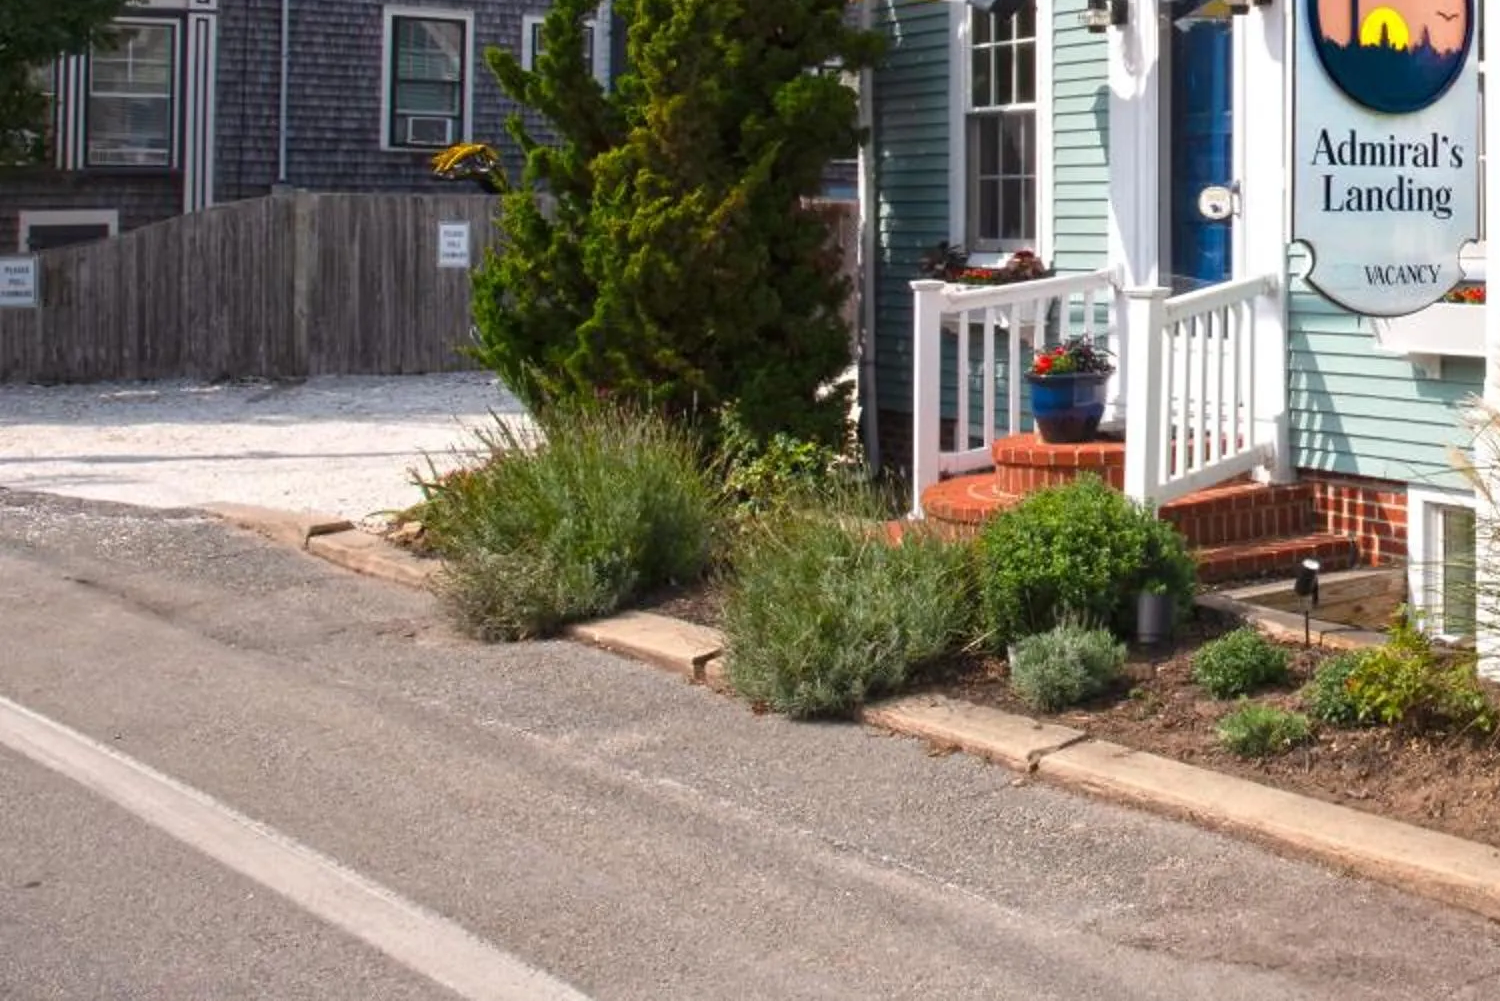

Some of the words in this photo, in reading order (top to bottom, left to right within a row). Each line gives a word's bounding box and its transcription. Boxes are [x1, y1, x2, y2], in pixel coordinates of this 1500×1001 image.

[1311, 128, 1464, 169] Admiral's
[1321, 173, 1453, 220] Landing
[1363, 263, 1443, 287] VACANCY
